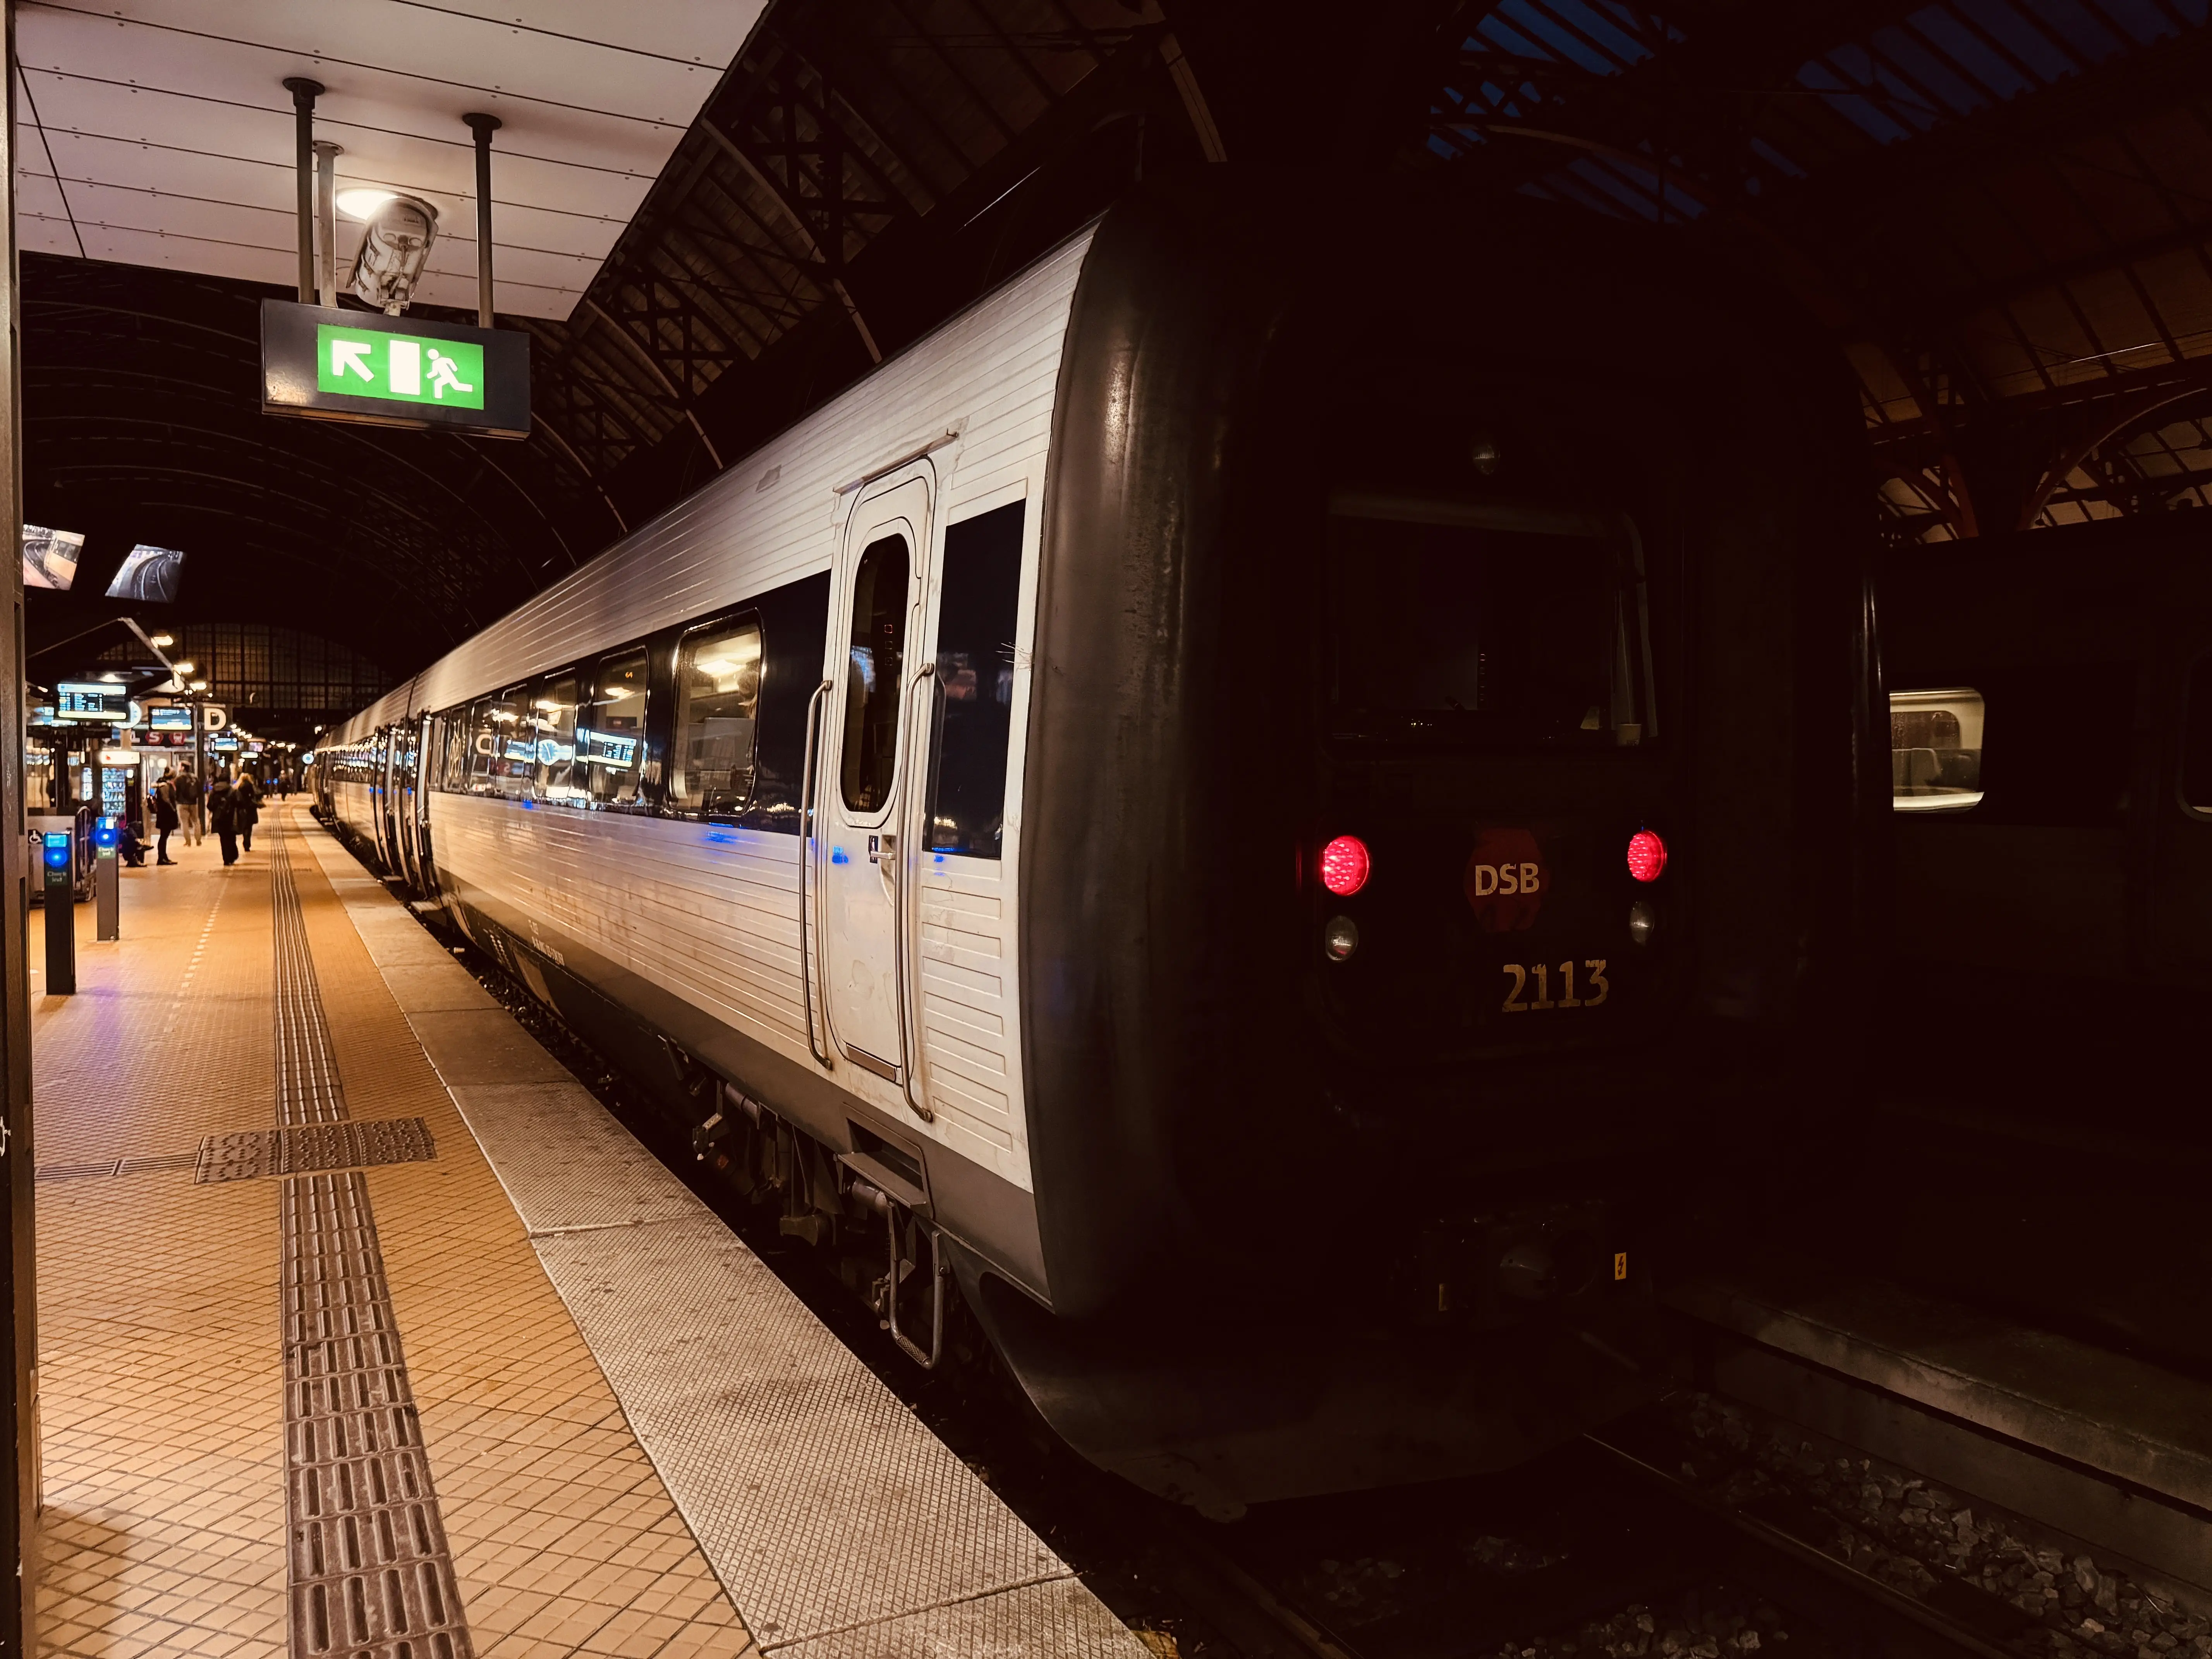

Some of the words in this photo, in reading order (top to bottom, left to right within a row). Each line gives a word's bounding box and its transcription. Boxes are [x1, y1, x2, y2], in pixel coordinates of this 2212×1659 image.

[204, 707, 226, 730] D
[149, 732, 160, 742] S
[1475, 862, 1539, 896] DSB
[1502, 959, 1609, 1013] 2113
